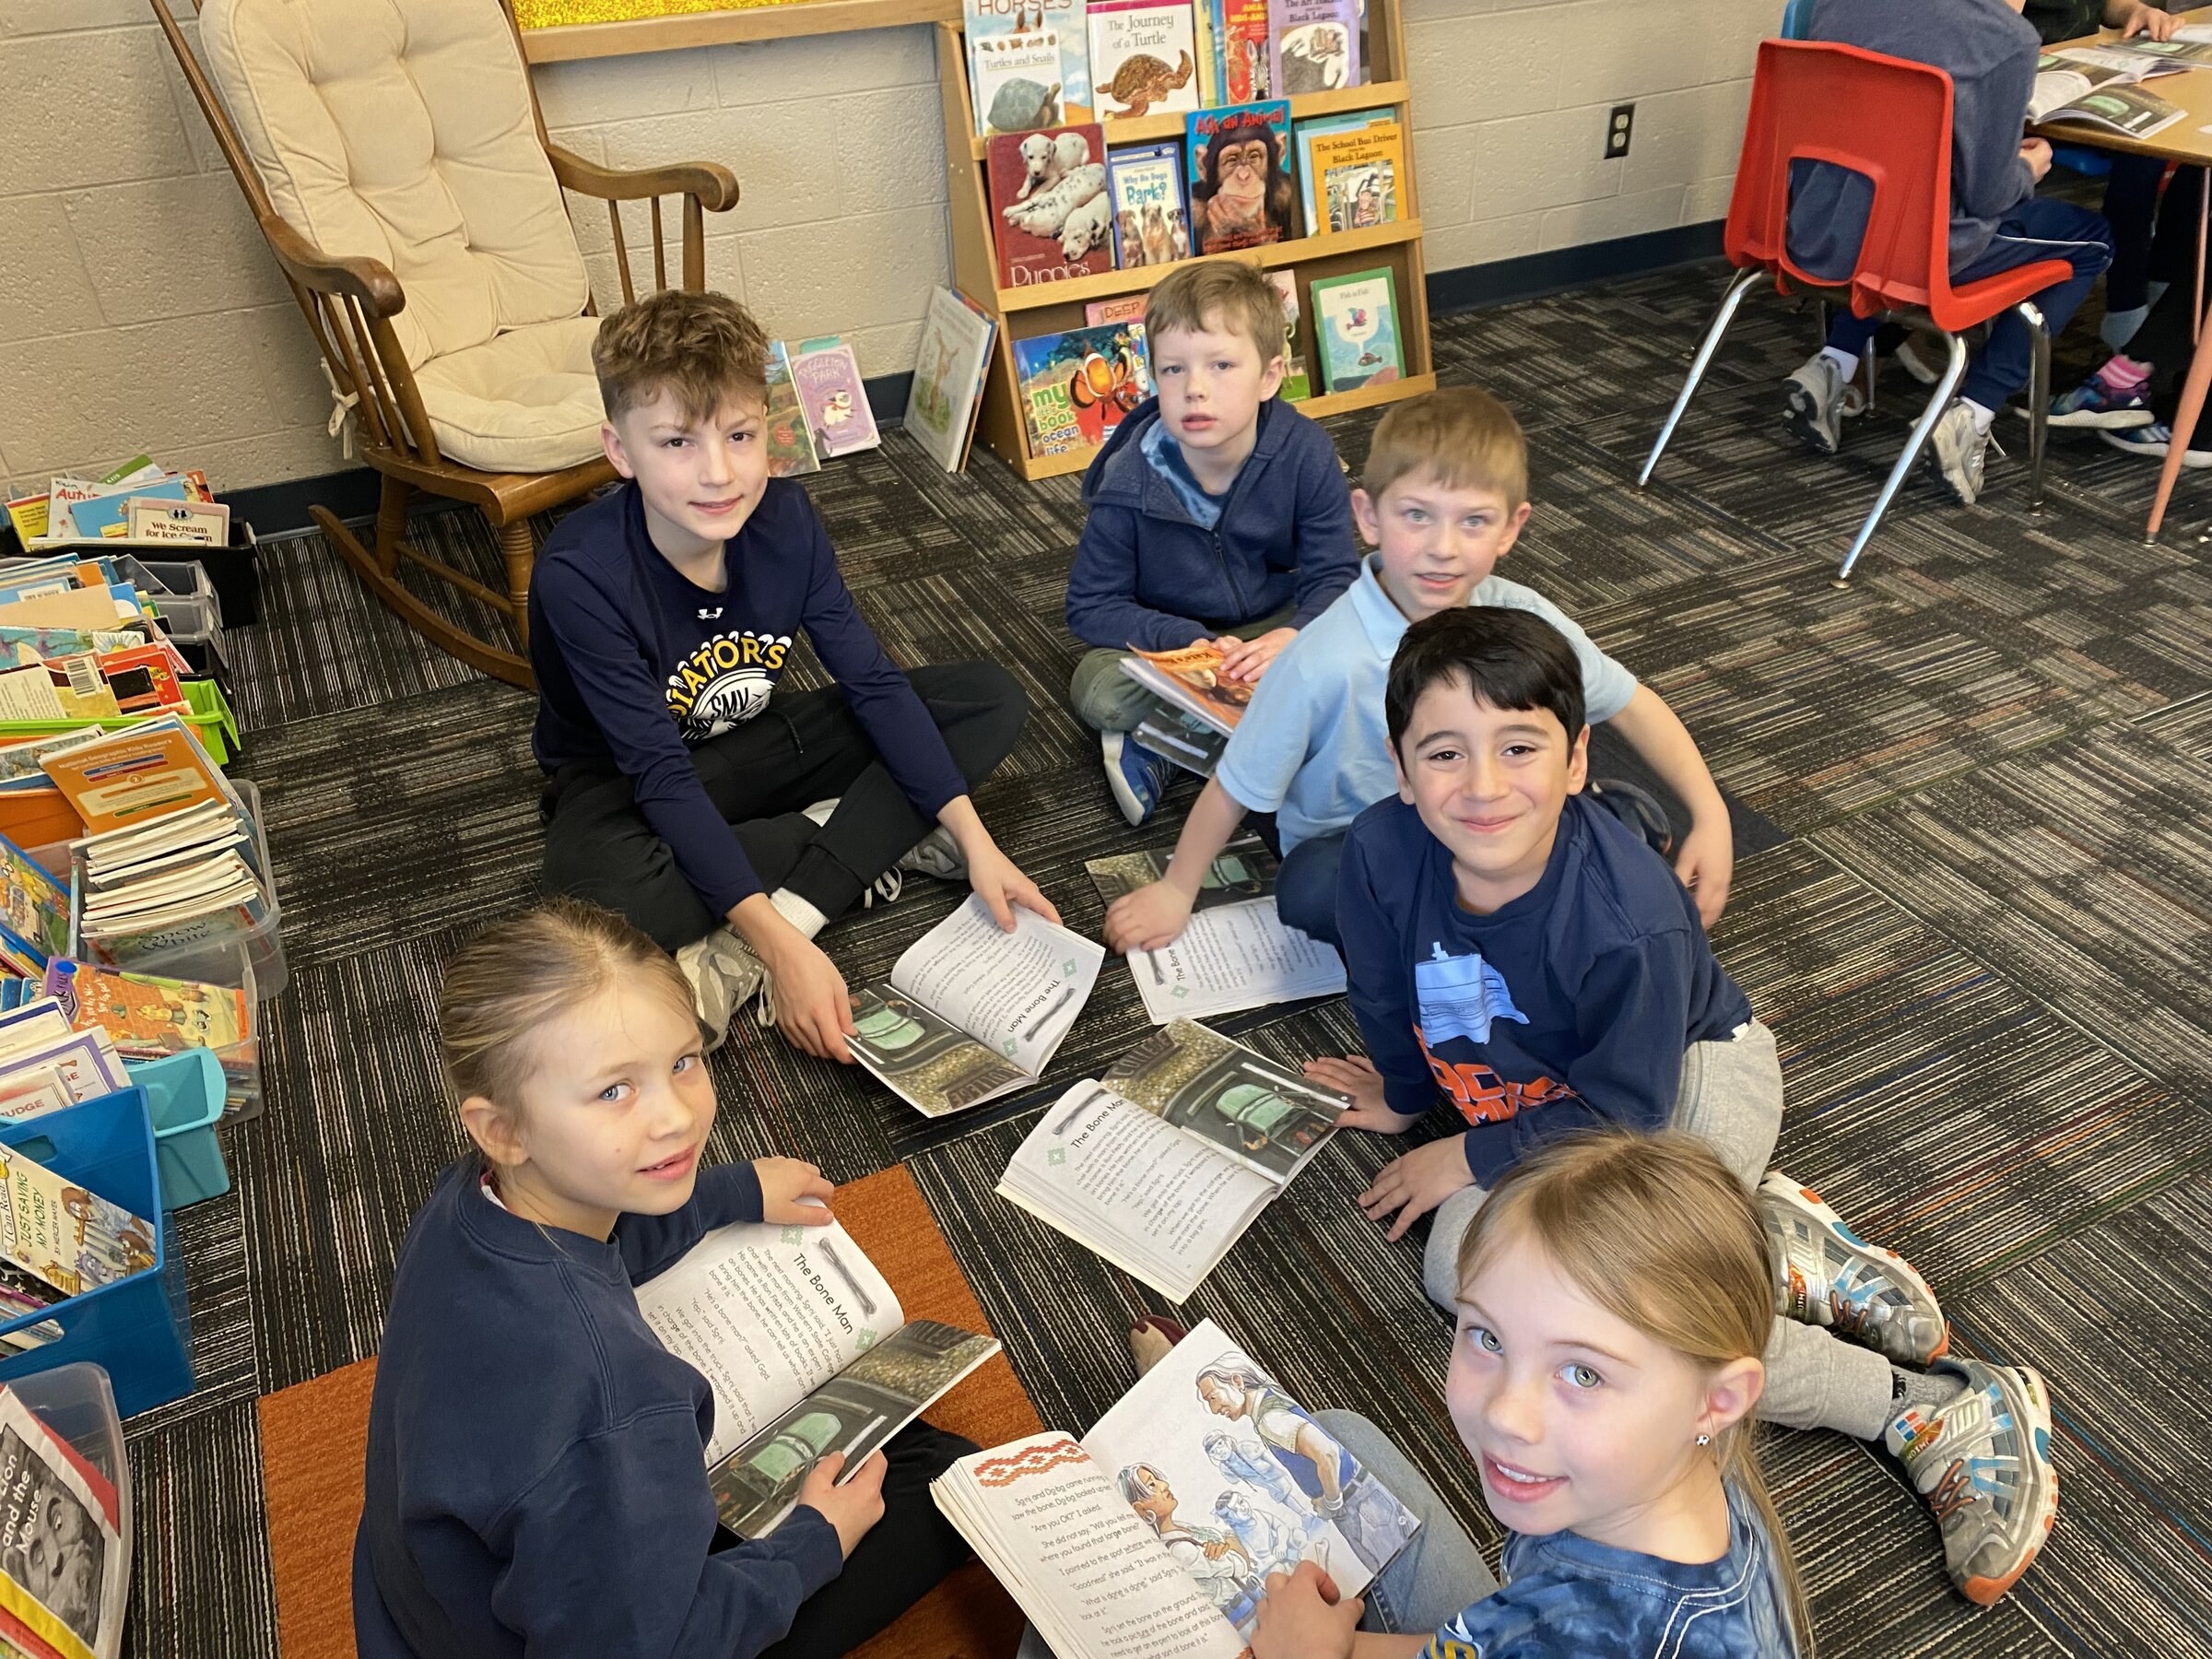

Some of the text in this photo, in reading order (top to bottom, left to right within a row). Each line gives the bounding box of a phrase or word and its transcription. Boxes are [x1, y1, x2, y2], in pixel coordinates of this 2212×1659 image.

[1108, 15, 1174, 32] The Journey
[1112, 37, 1124, 49] of
[1132, 30, 1167, 46] Turtle
[985, 57, 1012, 69] Turtles
[1014, 55, 1030, 65] and
[1316, 144, 1331, 152] The
[1333, 138, 1357, 149] School
[1359, 137, 1371, 146] Bus
[1373, 134, 1397, 143] Driver
[1333, 153, 1354, 164] Black
[1356, 149, 1384, 160] Lagoon
[1126, 182, 1167, 206] Bark?
[1104, 301, 1141, 318] DEEP
[1032, 383, 1069, 409] my
[1038, 411, 1075, 431] book
[1043, 426, 1078, 442] ocean
[1046, 444, 1067, 455] life
[146, 529, 159, 537] for
[151, 522, 207, 534] We Scream
[711, 688, 748, 719] SMV
[1169, 949, 1186, 981] The Bone
[1007, 980, 1061, 1032] The Bone Man
[0, 1100, 44, 1117] UDGE
[1069, 1132, 1089, 1148] The
[1086, 1110, 1110, 1132] Bone
[17, 1171, 33, 1248] JUST SAVING
[32, 1186, 48, 1250] MY MONEY
[4, 1215, 14, 1235] Can
[728, 1258, 735, 1267] on
[749, 1285, 758, 1296] He
[756, 1294, 767, 1307] has
[747, 1246, 759, 1260] chat
[771, 1277, 782, 1291] man
[782, 1290, 794, 1305] from
[793, 1253, 853, 1335] The Bone Man
[719, 1263, 732, 1281] bring
[767, 1328, 778, 1341] can
[788, 1359, 800, 1377] what
[717, 1308, 732, 1325] bone
[745, 1345, 761, 1364] asked
[676, 1306, 686, 1319] We
[700, 1342, 712, 1355] the
[732, 1388, 745, 1403] said
[741, 1402, 752, 1418] that
[1012, 1512, 1025, 1521] saw
[1025, 1506, 1038, 1516] the
[1075, 1488, 1097, 1500] looked
[1032, 1489, 1045, 1501] and
[1065, 1480, 1084, 1489] came
[3, 1469, 31, 1547] and the
[16, 1489, 42, 1556] Mouse
[1041, 1538, 1055, 1549] She
[1055, 1534, 1067, 1545] did
[1066, 1530, 1078, 1541] not
[1106, 1517, 1117, 1527] you
[1116, 1513, 1127, 1523] tell
[1047, 1517, 1061, 1528] you
[1040, 1551, 1060, 1563] where
[1060, 1547, 1073, 1559] you
[1072, 1539, 1092, 1552] found
[1091, 1535, 1106, 1546] that
[1105, 1529, 1123, 1541] large
[1065, 1561, 1090, 1576] pointed
[1089, 1558, 1098, 1567] to
[1097, 1554, 1110, 1564] the
[1110, 1548, 1124, 1561] spot
[1124, 1540, 1145, 1555] where
[1108, 1569, 1121, 1579] she
